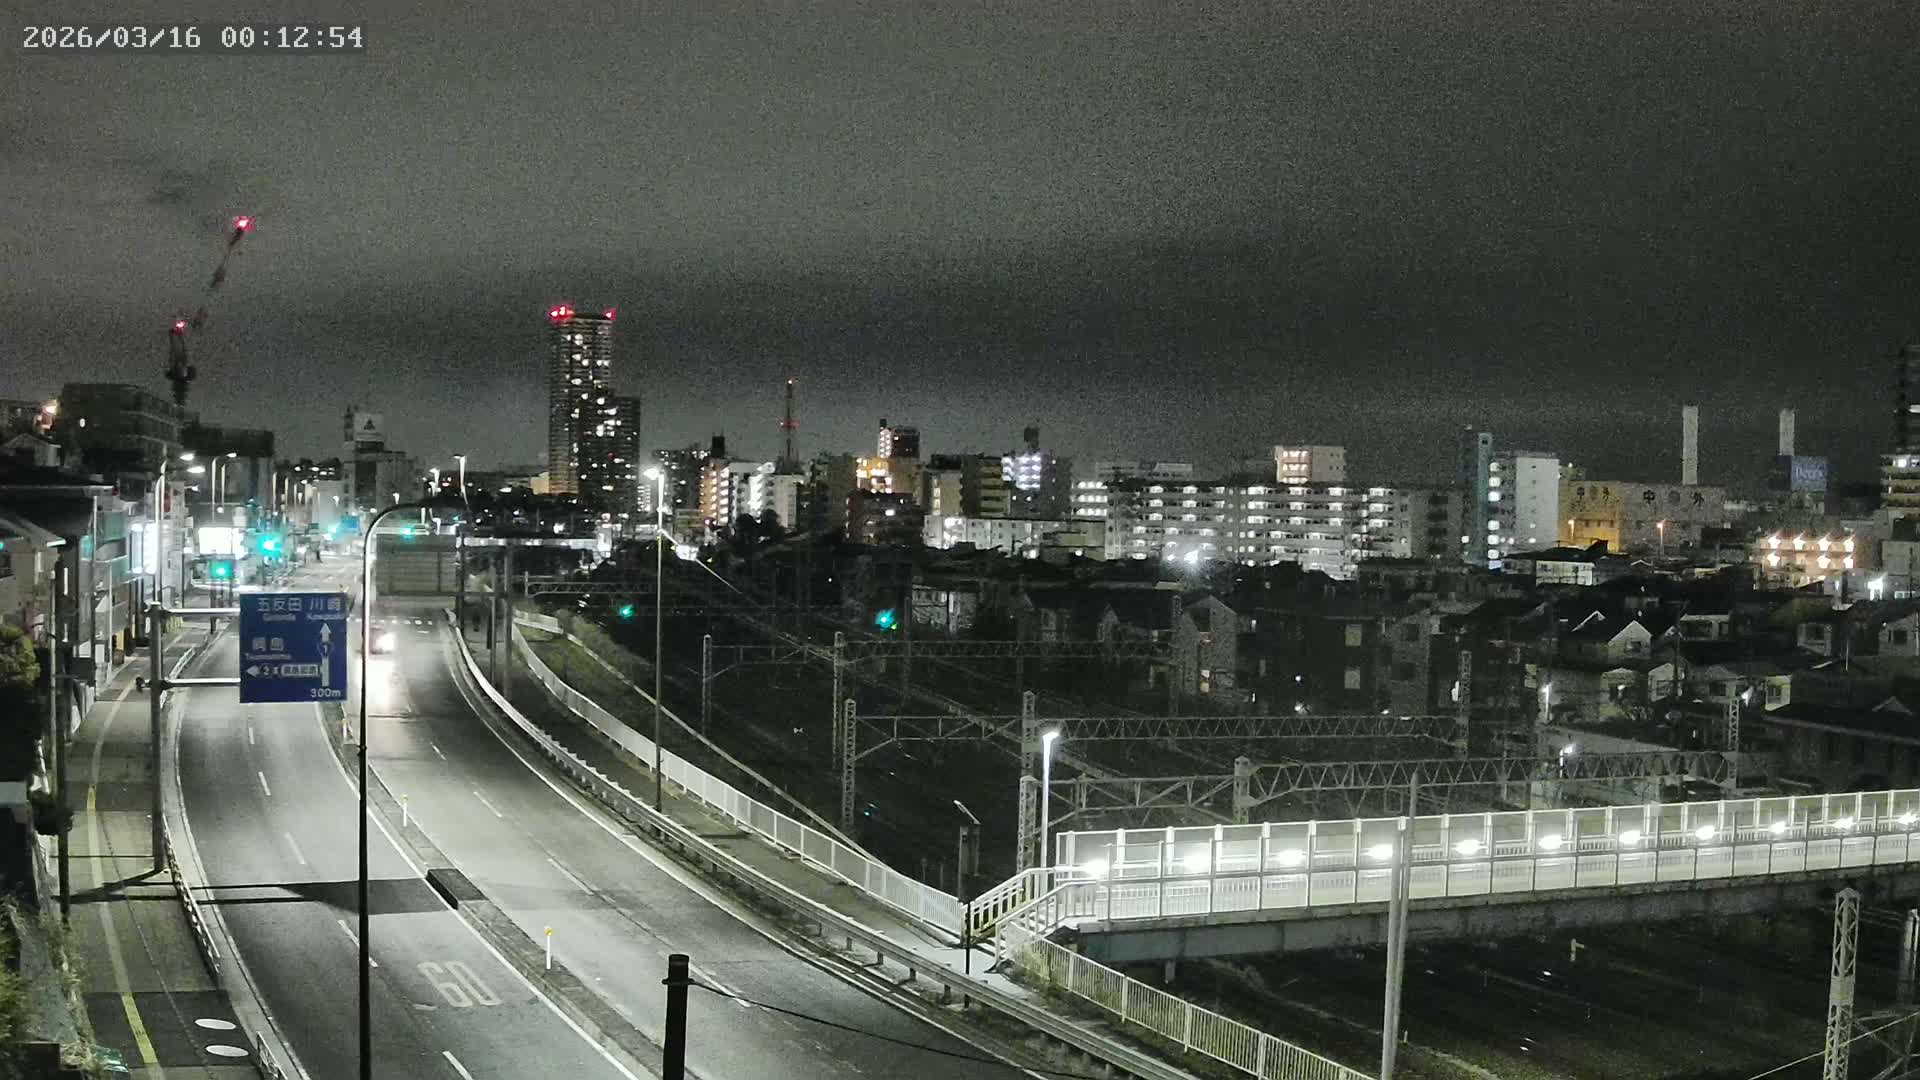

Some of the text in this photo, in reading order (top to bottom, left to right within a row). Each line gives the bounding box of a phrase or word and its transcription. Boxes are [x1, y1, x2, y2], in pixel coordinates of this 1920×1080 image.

[257, 597, 302, 612] 五反田
[310, 688, 341, 698] 300m
[417, 960, 505, 1007] 60
